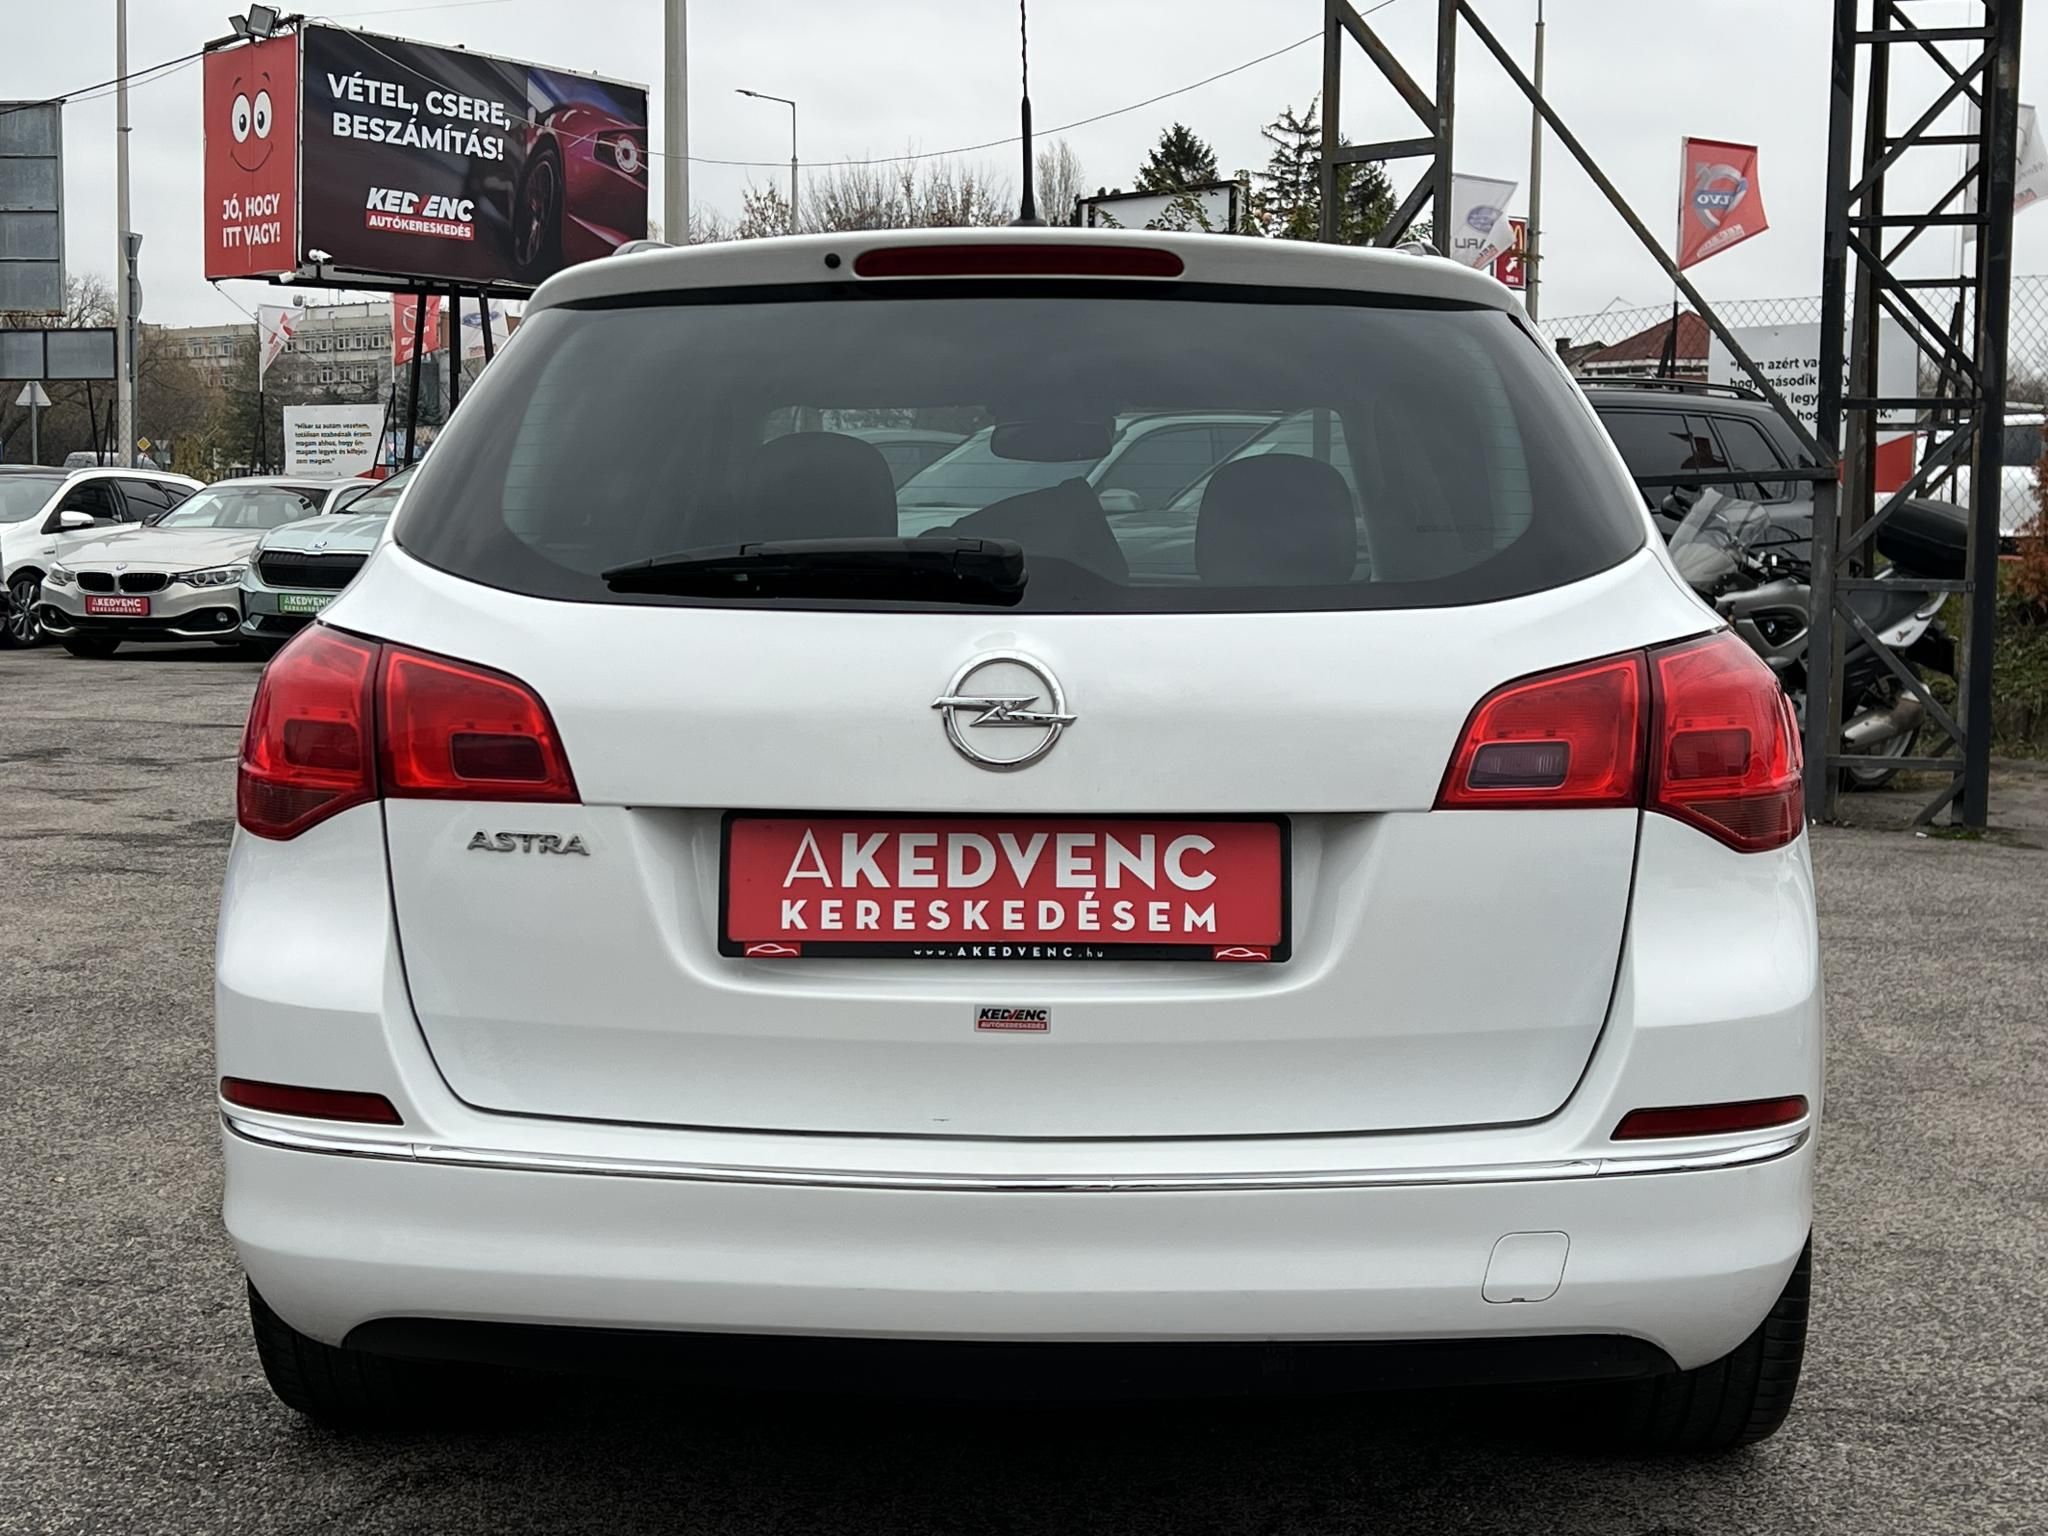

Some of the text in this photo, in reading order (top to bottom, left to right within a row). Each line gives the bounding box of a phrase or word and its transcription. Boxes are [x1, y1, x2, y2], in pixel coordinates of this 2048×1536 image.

[327, 71, 511, 131] VÉTEL, CSERE,
[332, 112, 504, 161] BESZÁMÍTÁS!
[222, 193, 281, 222] JÓ, HOGY
[366, 186, 475, 222] KEDVENC
[222, 222, 281, 248] ITT VAGY!
[368, 214, 472, 238] AUTÓKERESKEDÉS
[1768, 358, 1800, 370] azért
[92, 597, 141, 607] AKEDVENC
[467, 830, 591, 857] ASTRA
[782, 827, 1218, 891] AKEDVENC
[781, 891, 1217, 934] KERESKEDÉSEM
[913, 946, 1104, 958] www.AKEDVENC.hu
[979, 1008, 1048, 1021] KEDVENC
